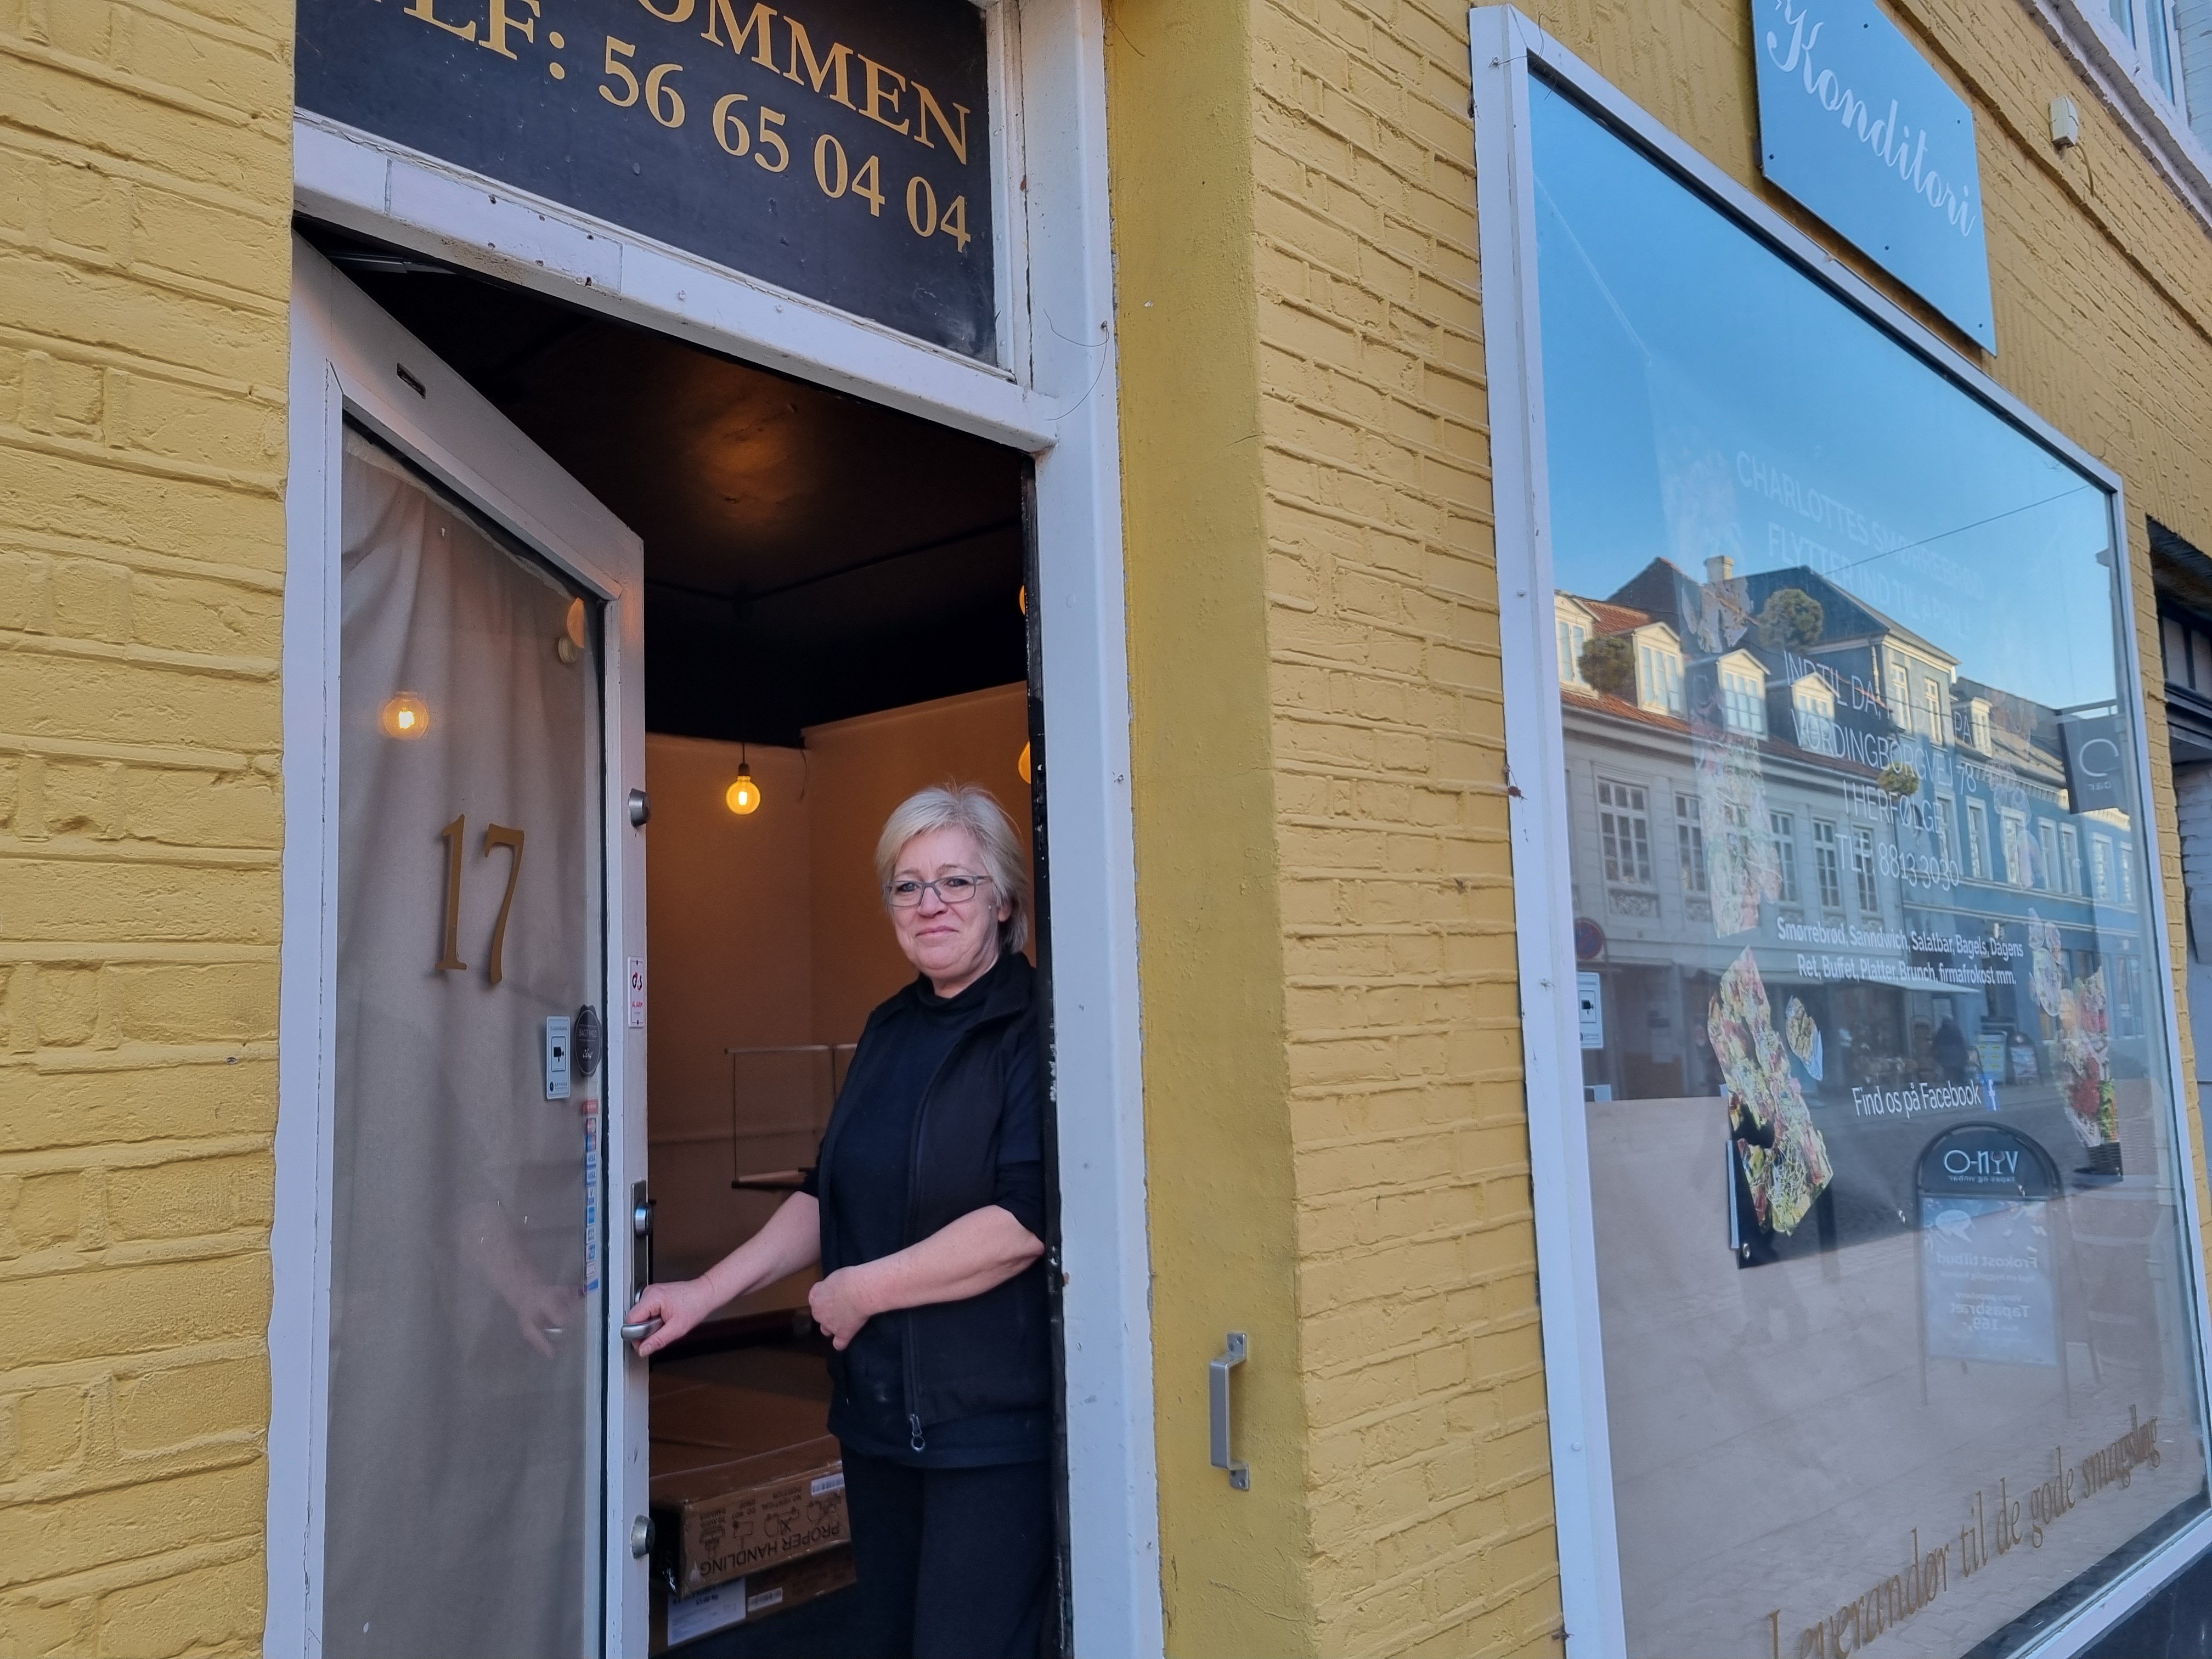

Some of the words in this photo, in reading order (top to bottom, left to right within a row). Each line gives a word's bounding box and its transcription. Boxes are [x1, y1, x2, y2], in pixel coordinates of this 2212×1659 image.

[599, 35, 685, 128] 56
[713, 94, 789, 172] 65
[814, 134, 885, 217] 04
[906, 176, 970, 253] 04
[1767, 0, 1976, 237] Konditori
[1737, 450, 1868, 546] CHARLOTTES
[1851, 674, 1881, 720] DA,
[1954, 704, 1973, 746] PÅ
[1791, 708, 1954, 788] VORDINGBORGVEJ
[1956, 762, 1977, 795] 78
[1853, 780, 1943, 835] HERFØLGE
[1878, 842, 1918, 888] 8813
[1920, 854, 1960, 892] 3030
[435, 814, 524, 984] 17
[1776, 916, 1849, 948] Smørrebrød,
[1911, 930, 1955, 956] Salatbar,
[1956, 934, 1990, 958] Bagels,
[1989, 936, 2024, 962] Dagens
[1797, 953, 1822, 980] Ret,
[1822, 956, 1860, 983] Buffet,
[1860, 957, 1899, 984] Platter,
[1899, 961, 1938, 984] Brunch,
[1938, 963, 1996, 985] firmafrokost
[1996, 968, 2017, 985] mm.
[1852, 1084, 1884, 1117] Find
[1886, 1092, 1903, 1114] os
[1903, 1081, 1921, 1120] på
[1921, 1079, 1982, 1111] Facebook
[782, 1521, 840, 1552] PROPER
[1960, 1489, 1990, 1578] til
[1996, 1477, 2023, 1555] de
[2030, 1446, 2076, 1549] gode
[700, 1541, 777, 1577] HANDLING
